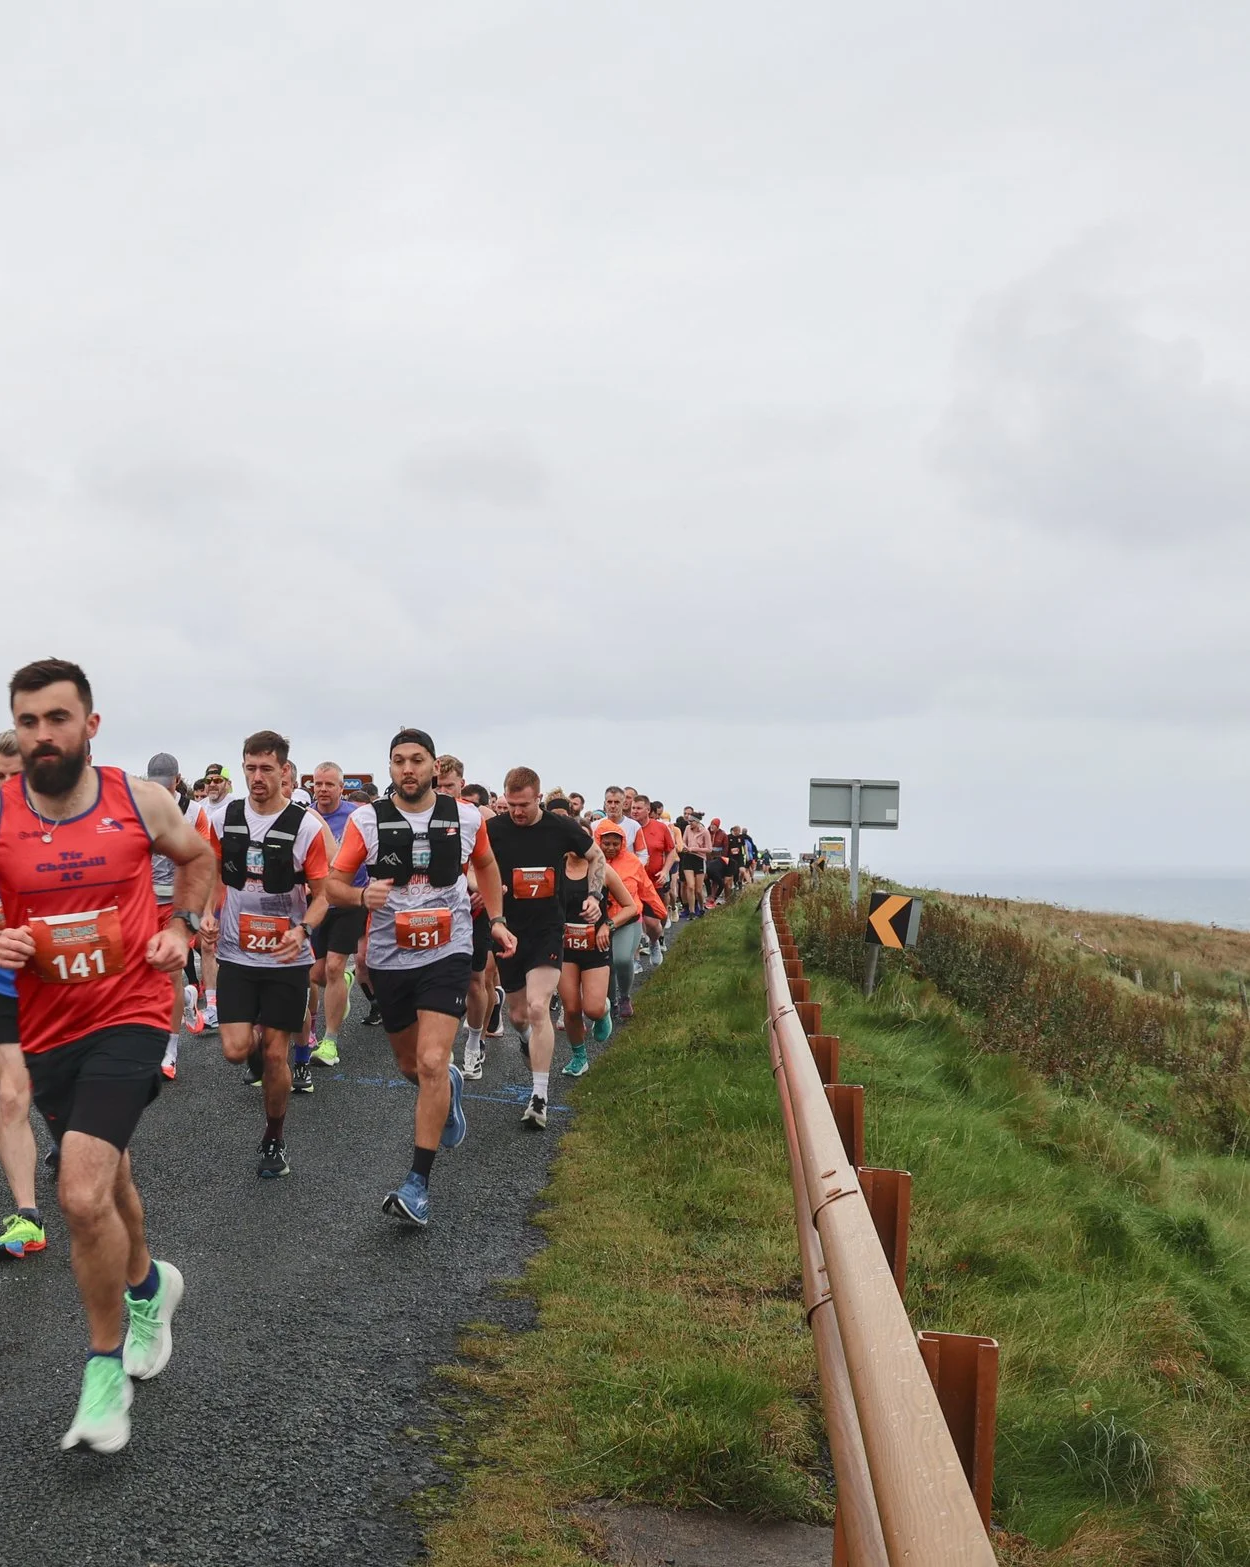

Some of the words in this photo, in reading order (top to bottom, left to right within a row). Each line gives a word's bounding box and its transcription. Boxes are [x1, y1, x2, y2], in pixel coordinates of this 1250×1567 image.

[60, 871, 83, 882] AC
[529, 884, 539, 897] 7
[246, 934, 278, 951] 244
[408, 930, 440, 947] 131
[567, 938, 589, 949] 154
[51, 948, 106, 980] 141
